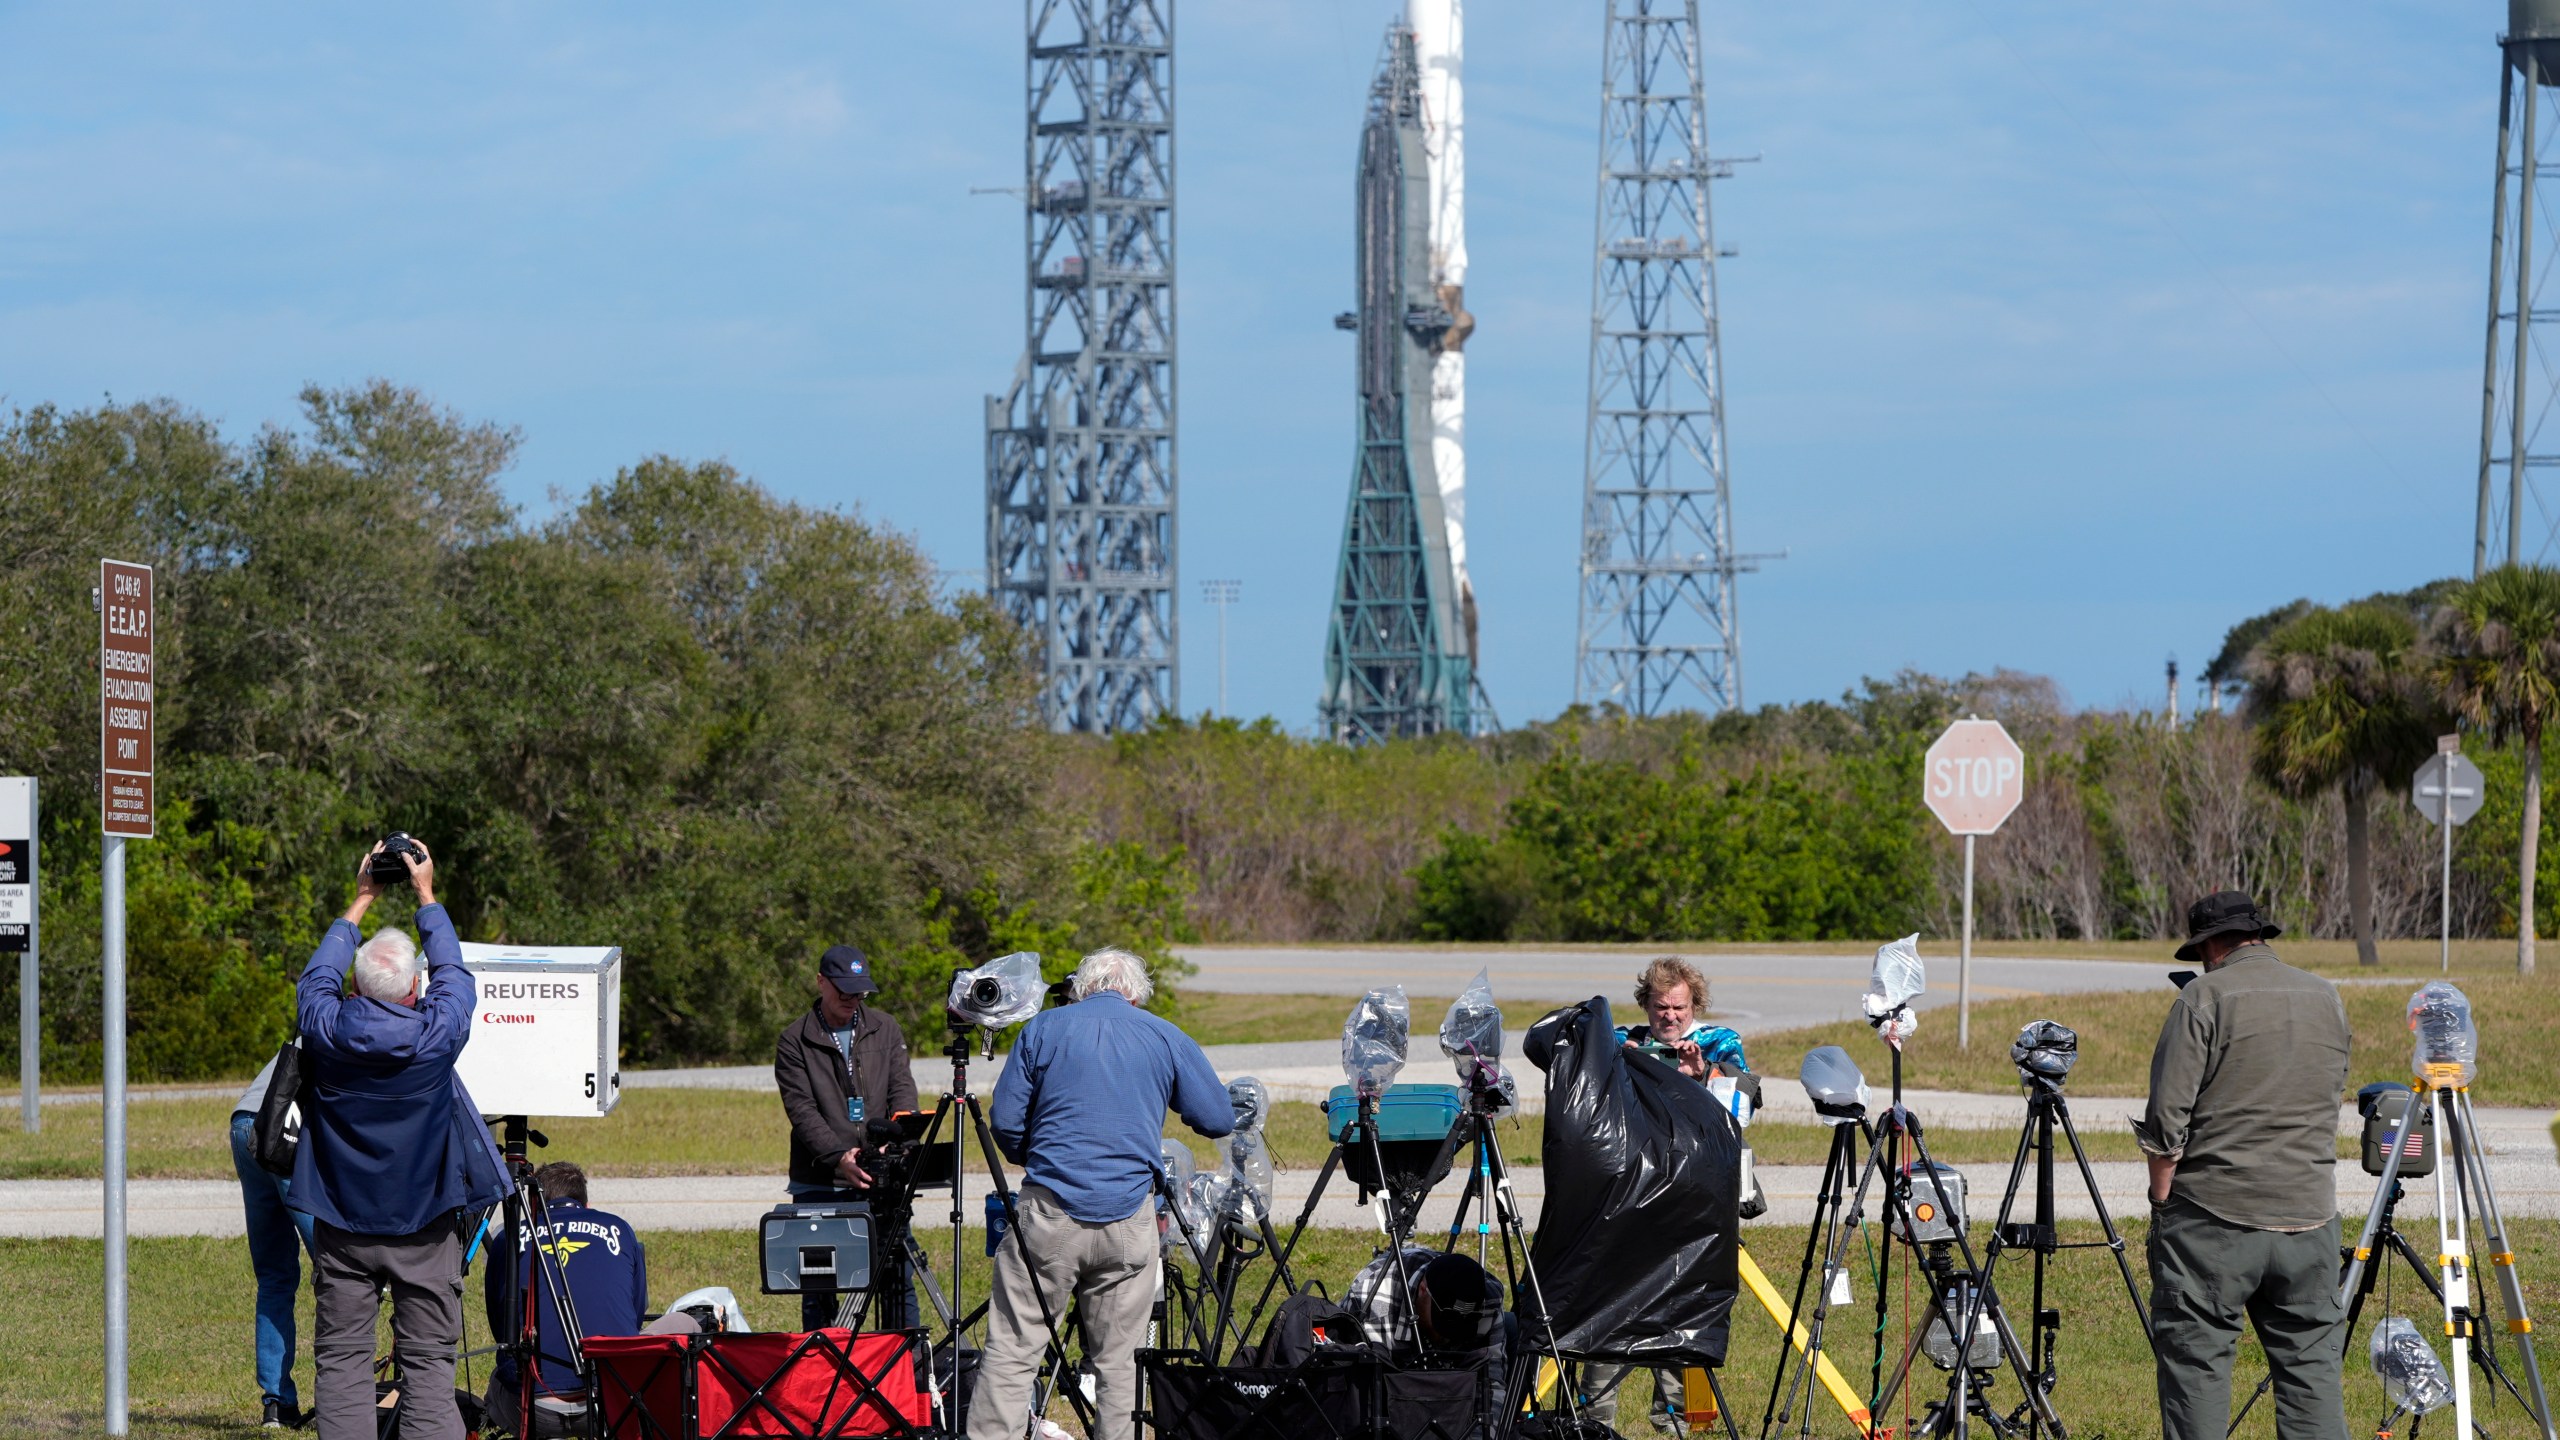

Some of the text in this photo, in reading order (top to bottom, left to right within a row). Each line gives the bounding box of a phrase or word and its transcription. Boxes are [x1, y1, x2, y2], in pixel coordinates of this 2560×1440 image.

[115, 573, 133, 597] CX46
[110, 605, 147, 638] E.E.A.P.
[105, 648, 150, 674] EMERGENCY
[105, 677, 151, 702] EVACUATION
[109, 706, 147, 731] ASSEMBLY
[118, 738, 138, 760] POINT
[1933, 756, 2016, 798] STOP
[2, 899, 13, 908] THE
[7, 888, 24, 897] AREA
[483, 983, 580, 999] REUTERS
[483, 1012, 535, 1024] Canon
[584, 1072, 595, 1098] 5
[567, 1221, 621, 1256] RIDERS
